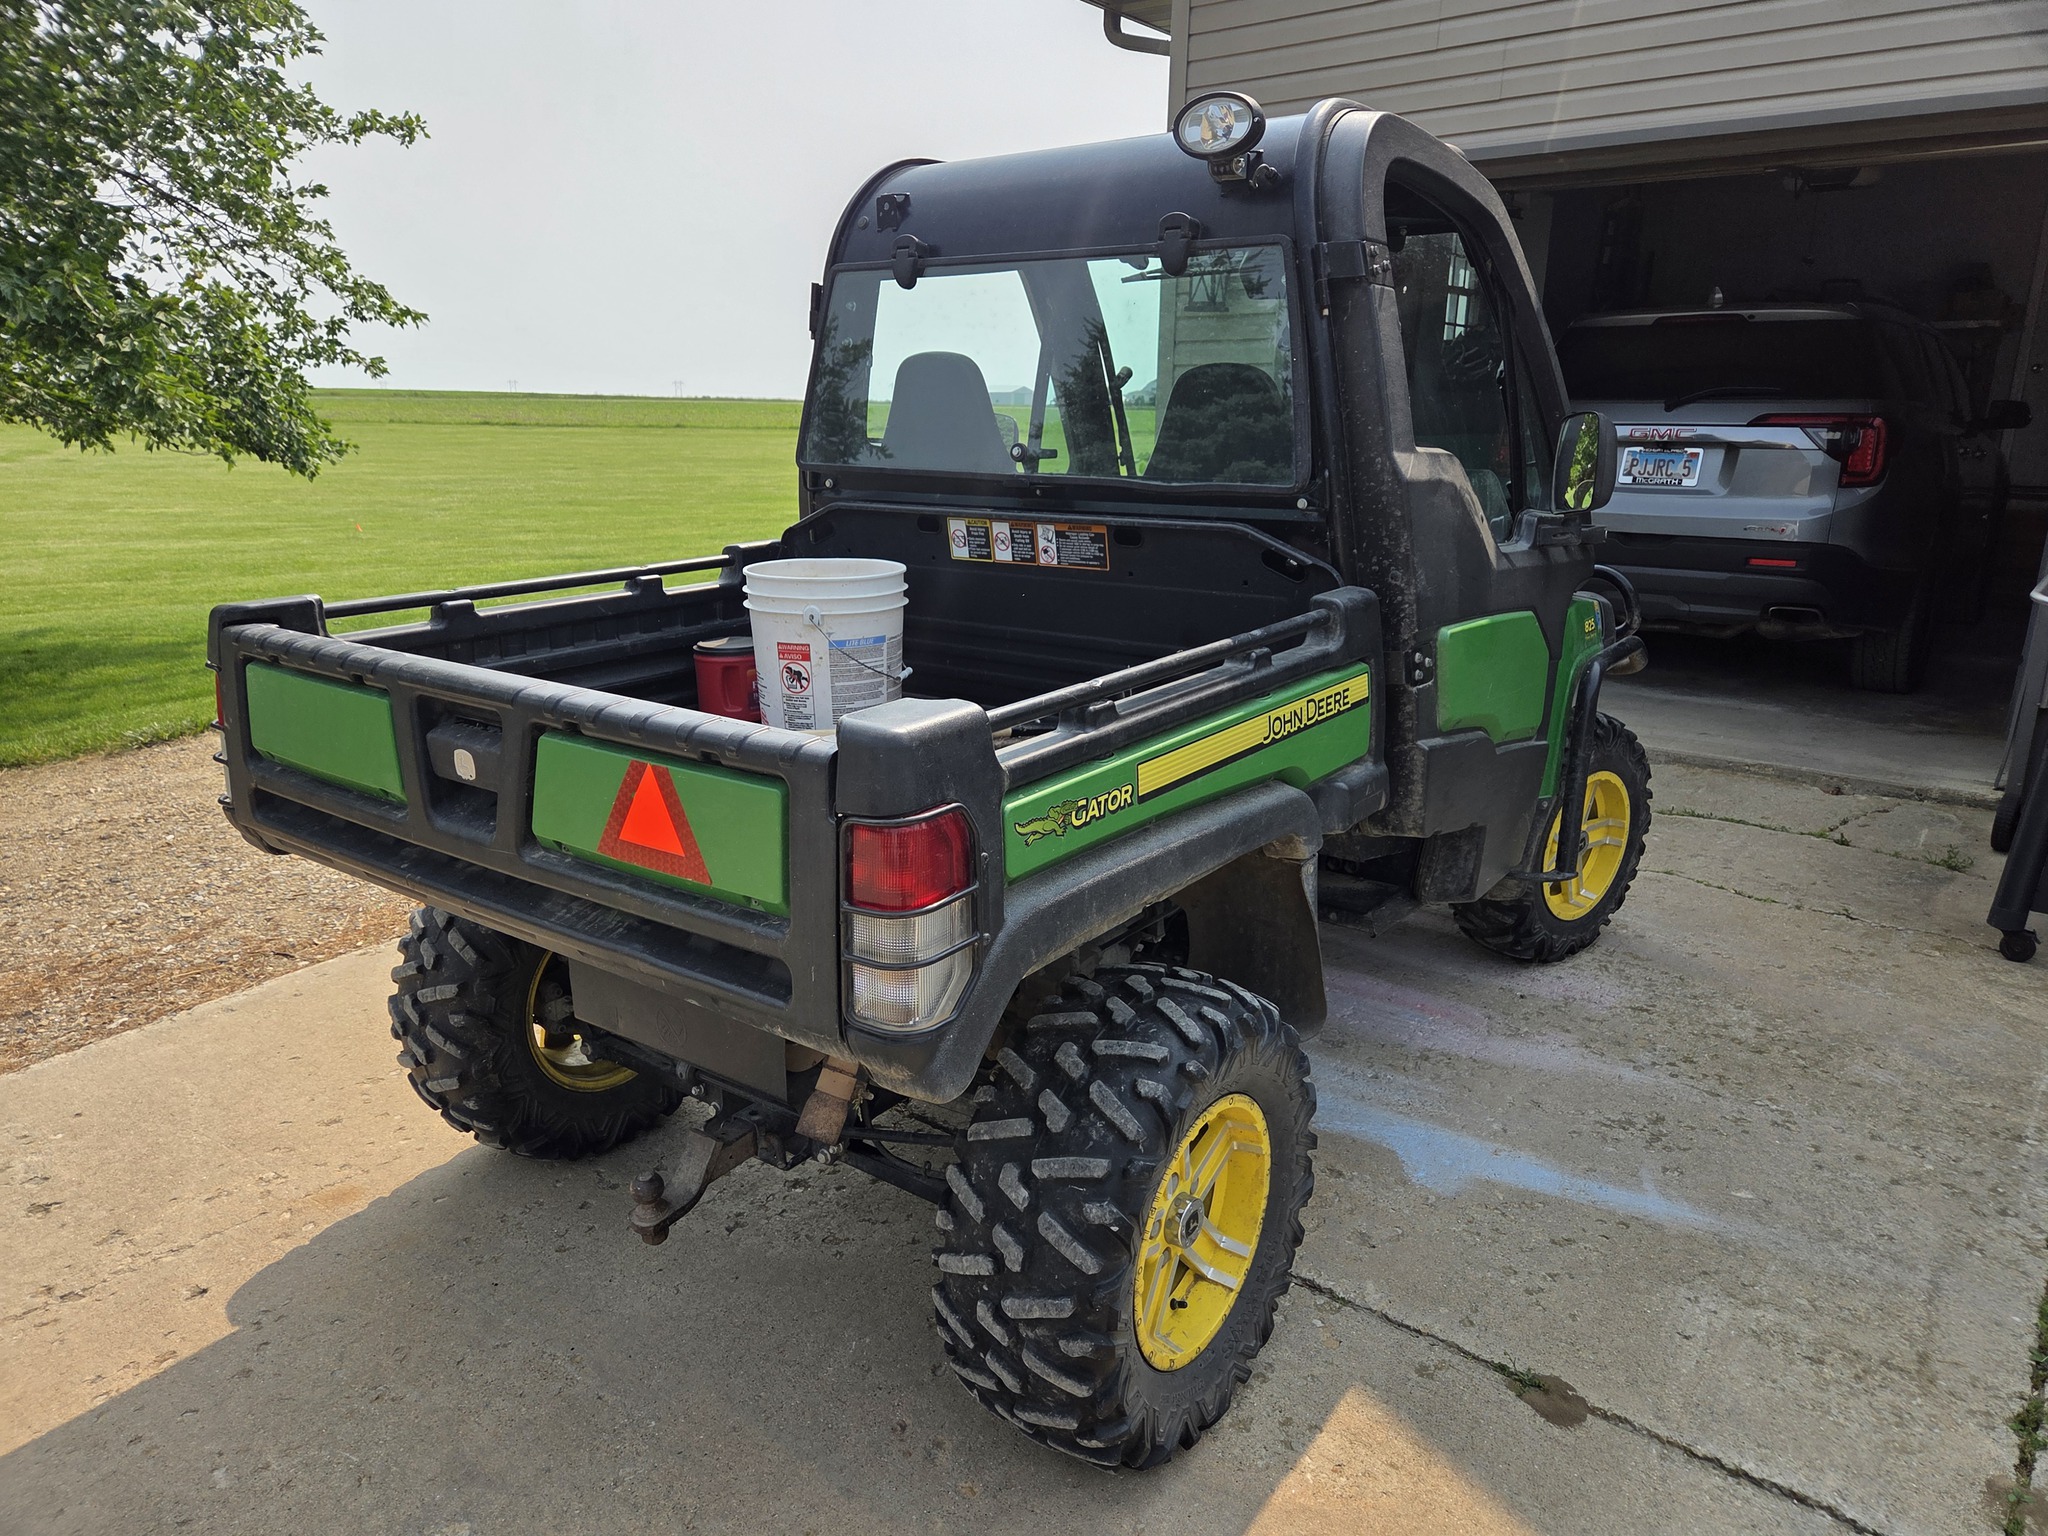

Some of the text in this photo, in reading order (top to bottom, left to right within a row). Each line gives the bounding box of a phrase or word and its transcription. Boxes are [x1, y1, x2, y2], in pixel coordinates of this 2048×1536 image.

[1629, 427, 1697, 440] GMC
[1630, 458, 1693, 477] PJJRC 5
[780, 643, 810, 651] WARNING
[1263, 687, 1351, 743] JOHN DEERE
[1070, 783, 1134, 828] GATOR
